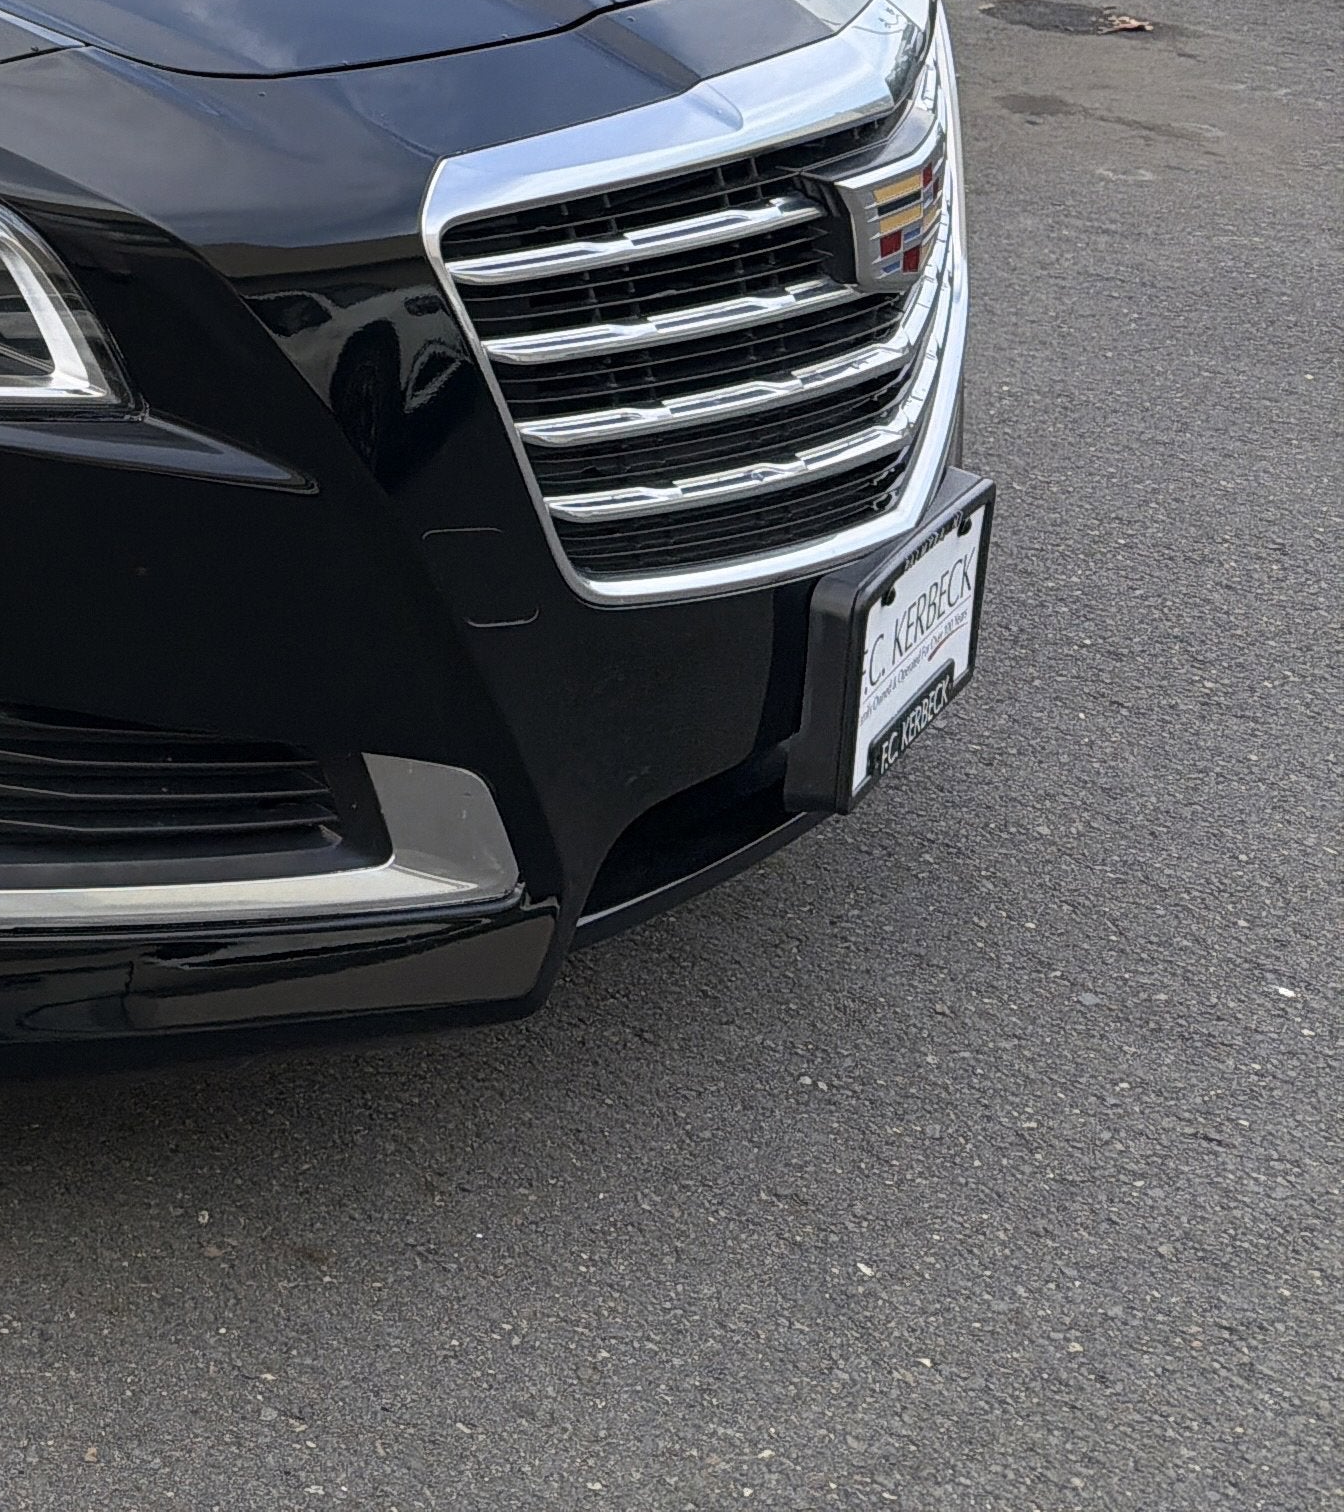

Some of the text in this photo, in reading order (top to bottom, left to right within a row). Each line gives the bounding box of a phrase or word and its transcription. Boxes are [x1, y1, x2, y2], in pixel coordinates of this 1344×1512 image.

[892, 546, 976, 661] KERBECK
[872, 678, 894, 711] Owned
[900, 674, 950, 750] KERBECK
